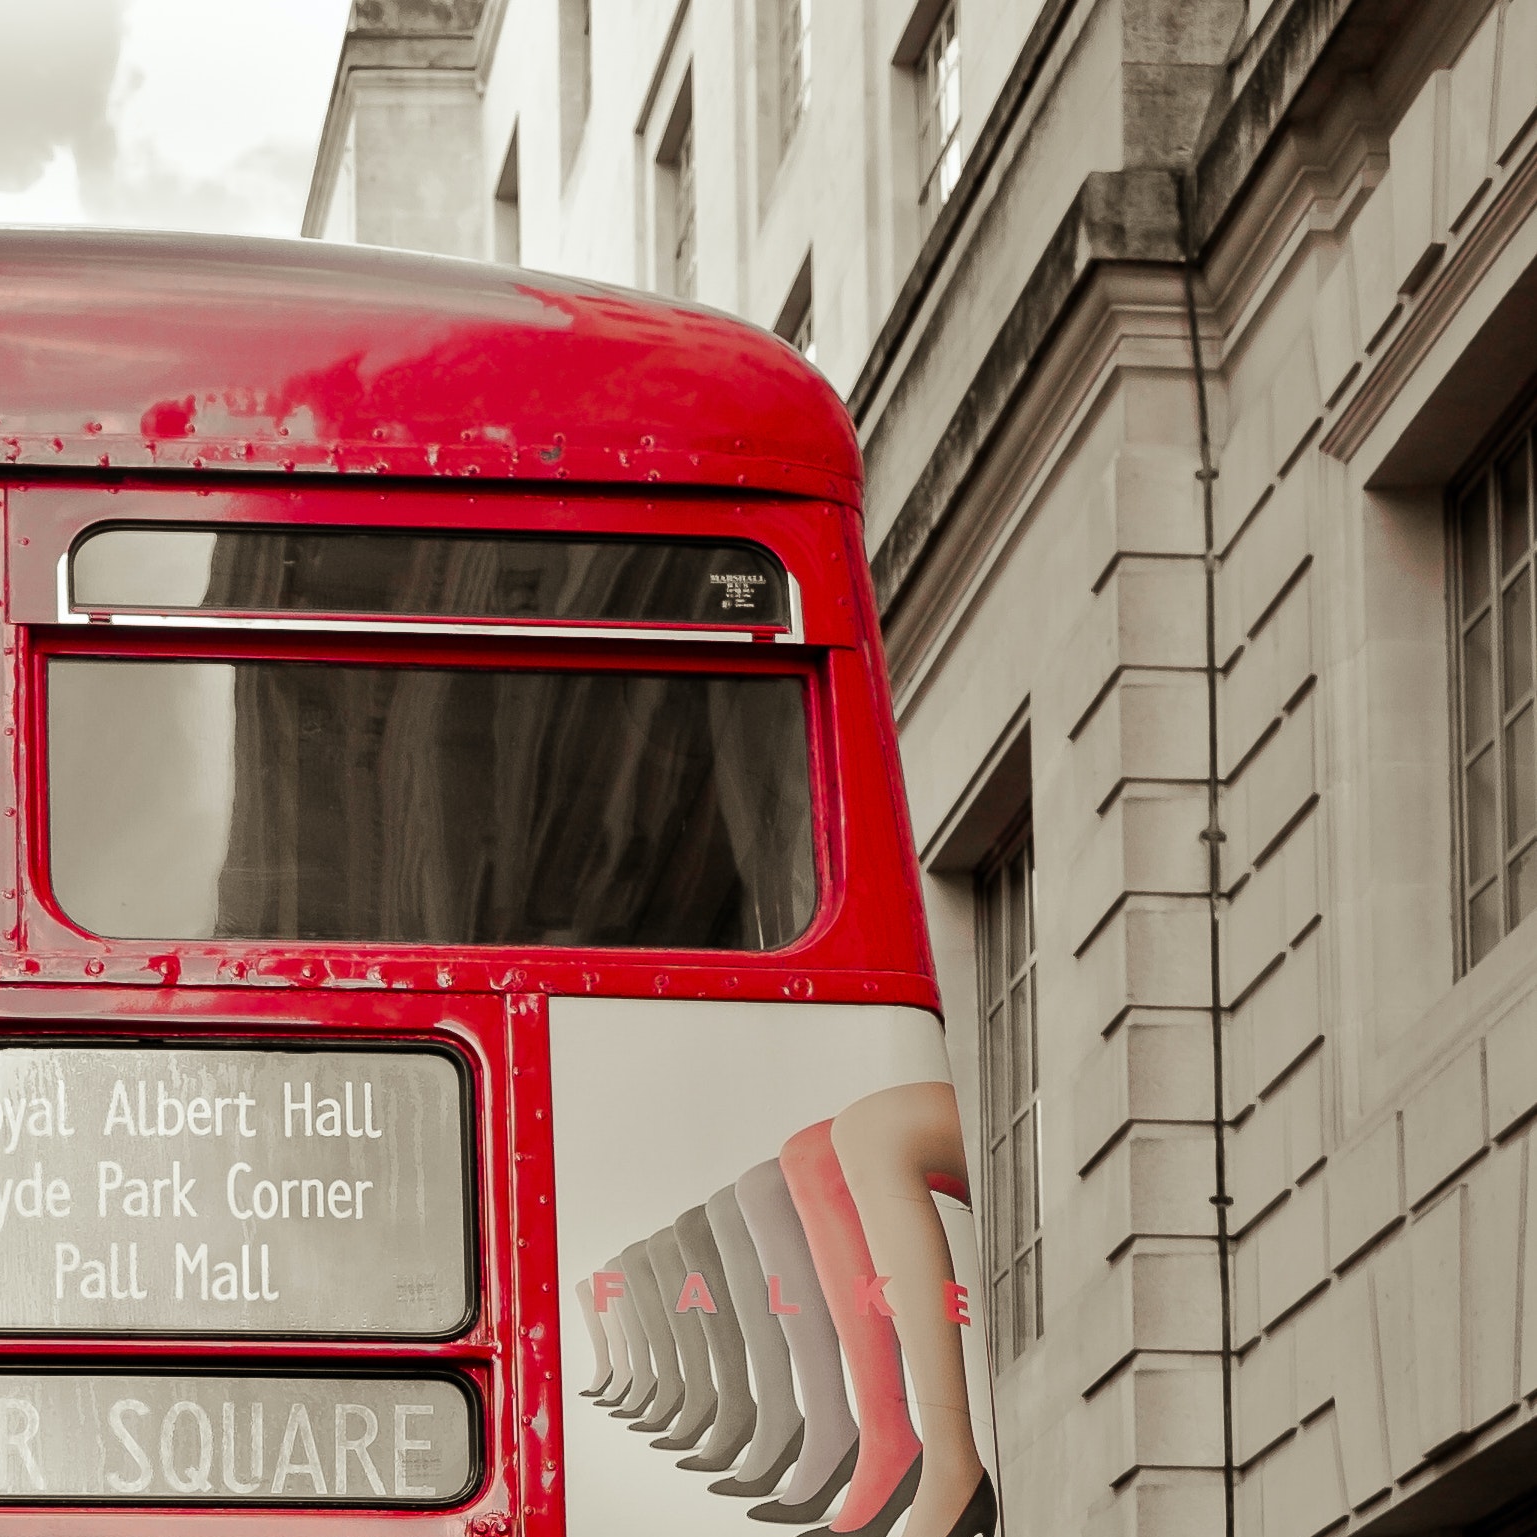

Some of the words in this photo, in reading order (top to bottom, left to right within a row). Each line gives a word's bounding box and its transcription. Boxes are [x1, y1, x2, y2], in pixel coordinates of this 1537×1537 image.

[709, 573, 766, 583] MARSHALL
[103, 1080, 257, 1138] Albert
[284, 1082, 382, 1138] Hall
[98, 1160, 198, 1218] Park
[227, 1161, 373, 1220] Corner
[55, 1242, 148, 1300] Pall
[175, 1242, 280, 1301] Mall
[593, 1272, 972, 1327] FALKE
[105, 1398, 437, 1496] SQUARE
